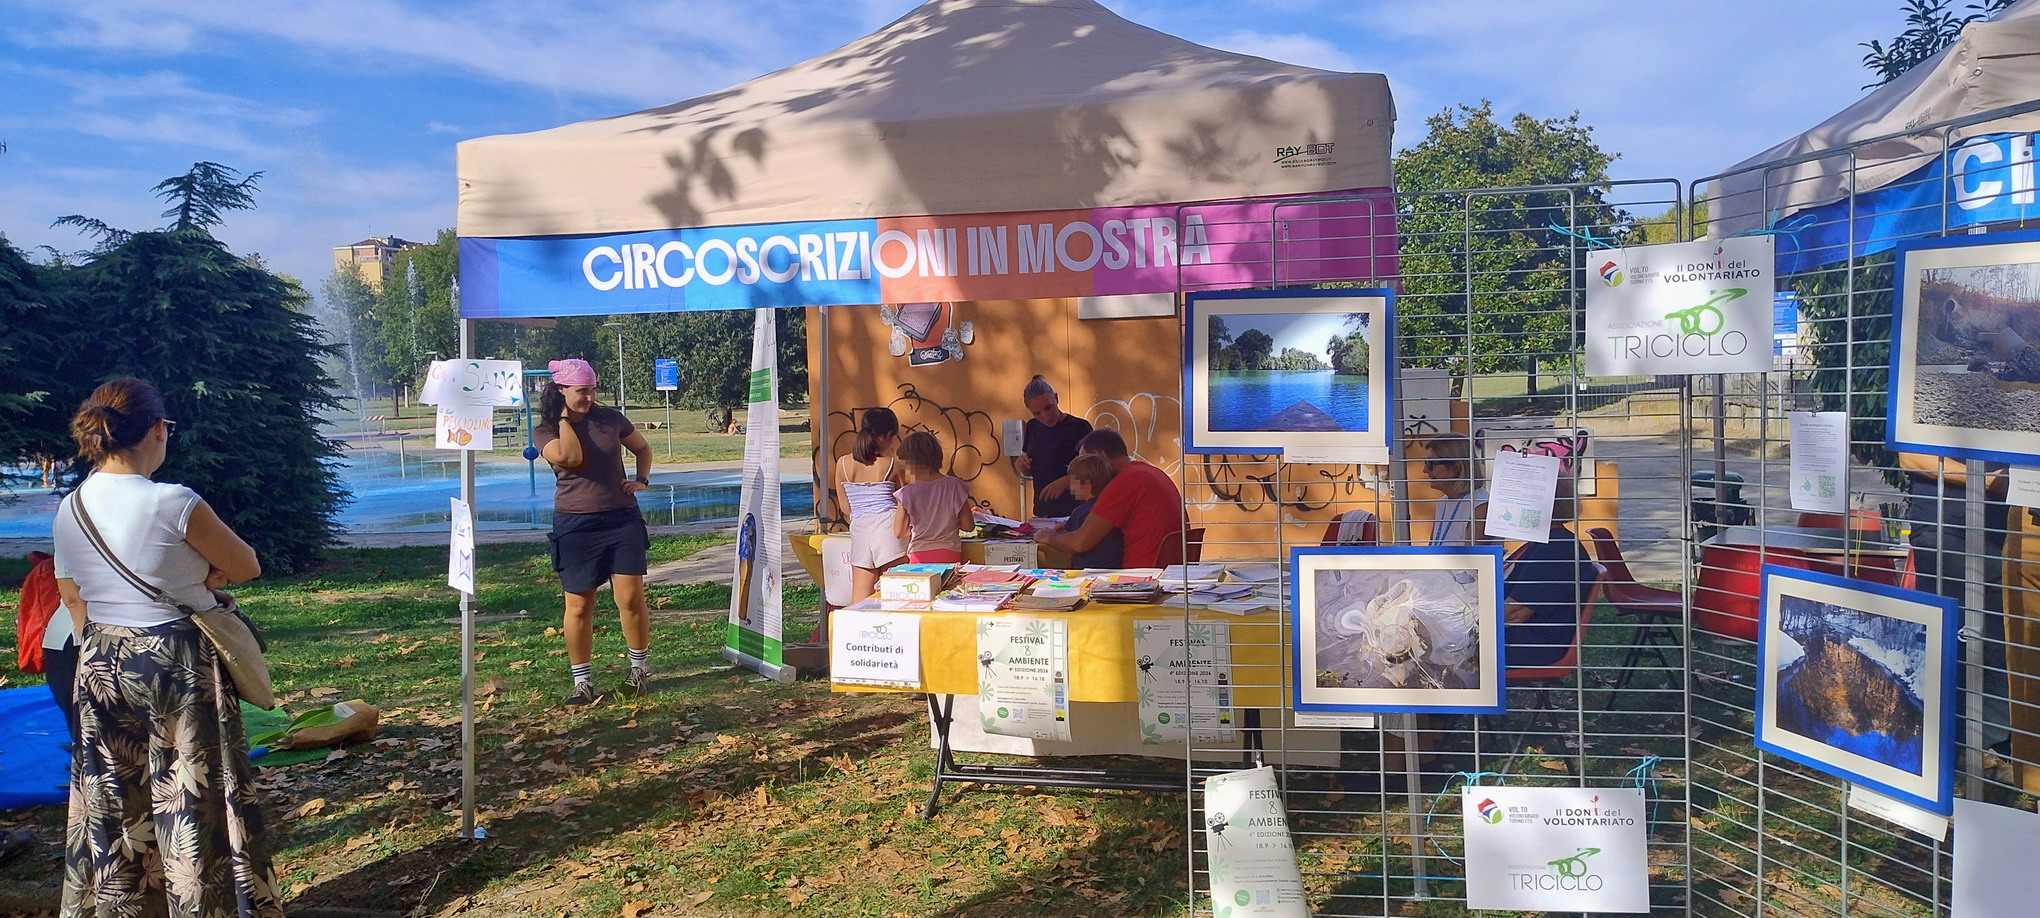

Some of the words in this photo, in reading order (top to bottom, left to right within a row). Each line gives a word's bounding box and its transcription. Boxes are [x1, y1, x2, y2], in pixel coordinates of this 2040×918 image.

[1276, 146, 1301, 157] RAY
[1307, 143, 1335, 155] BOT
[582, 227, 958, 291] CIRCOSCRIZIONI
[966, 225, 1008, 276] IN
[1016, 214, 1212, 273] MOSTRA
[1728, 260, 1746, 269] del
[1664, 269, 1760, 283] VOLONTARIATO
[1607, 320, 1663, 330] ASSOCIAZIONE
[1607, 330, 1748, 360] TRICICLO
[463, 362, 522, 391] SALVA
[858, 630, 893, 640] TRICICLO
[1010, 636, 1044, 645] FESTIVAL
[846, 643, 892, 653] Contributi
[895, 646, 904, 654] di
[850, 659, 898, 669] solidarietà
[1009, 657, 1049, 665] AMBIENTE
[1604, 808, 1621, 816] del
[1543, 818, 1634, 826] VOLONTARIATO
[1508, 873, 1603, 891] TRICICLO
